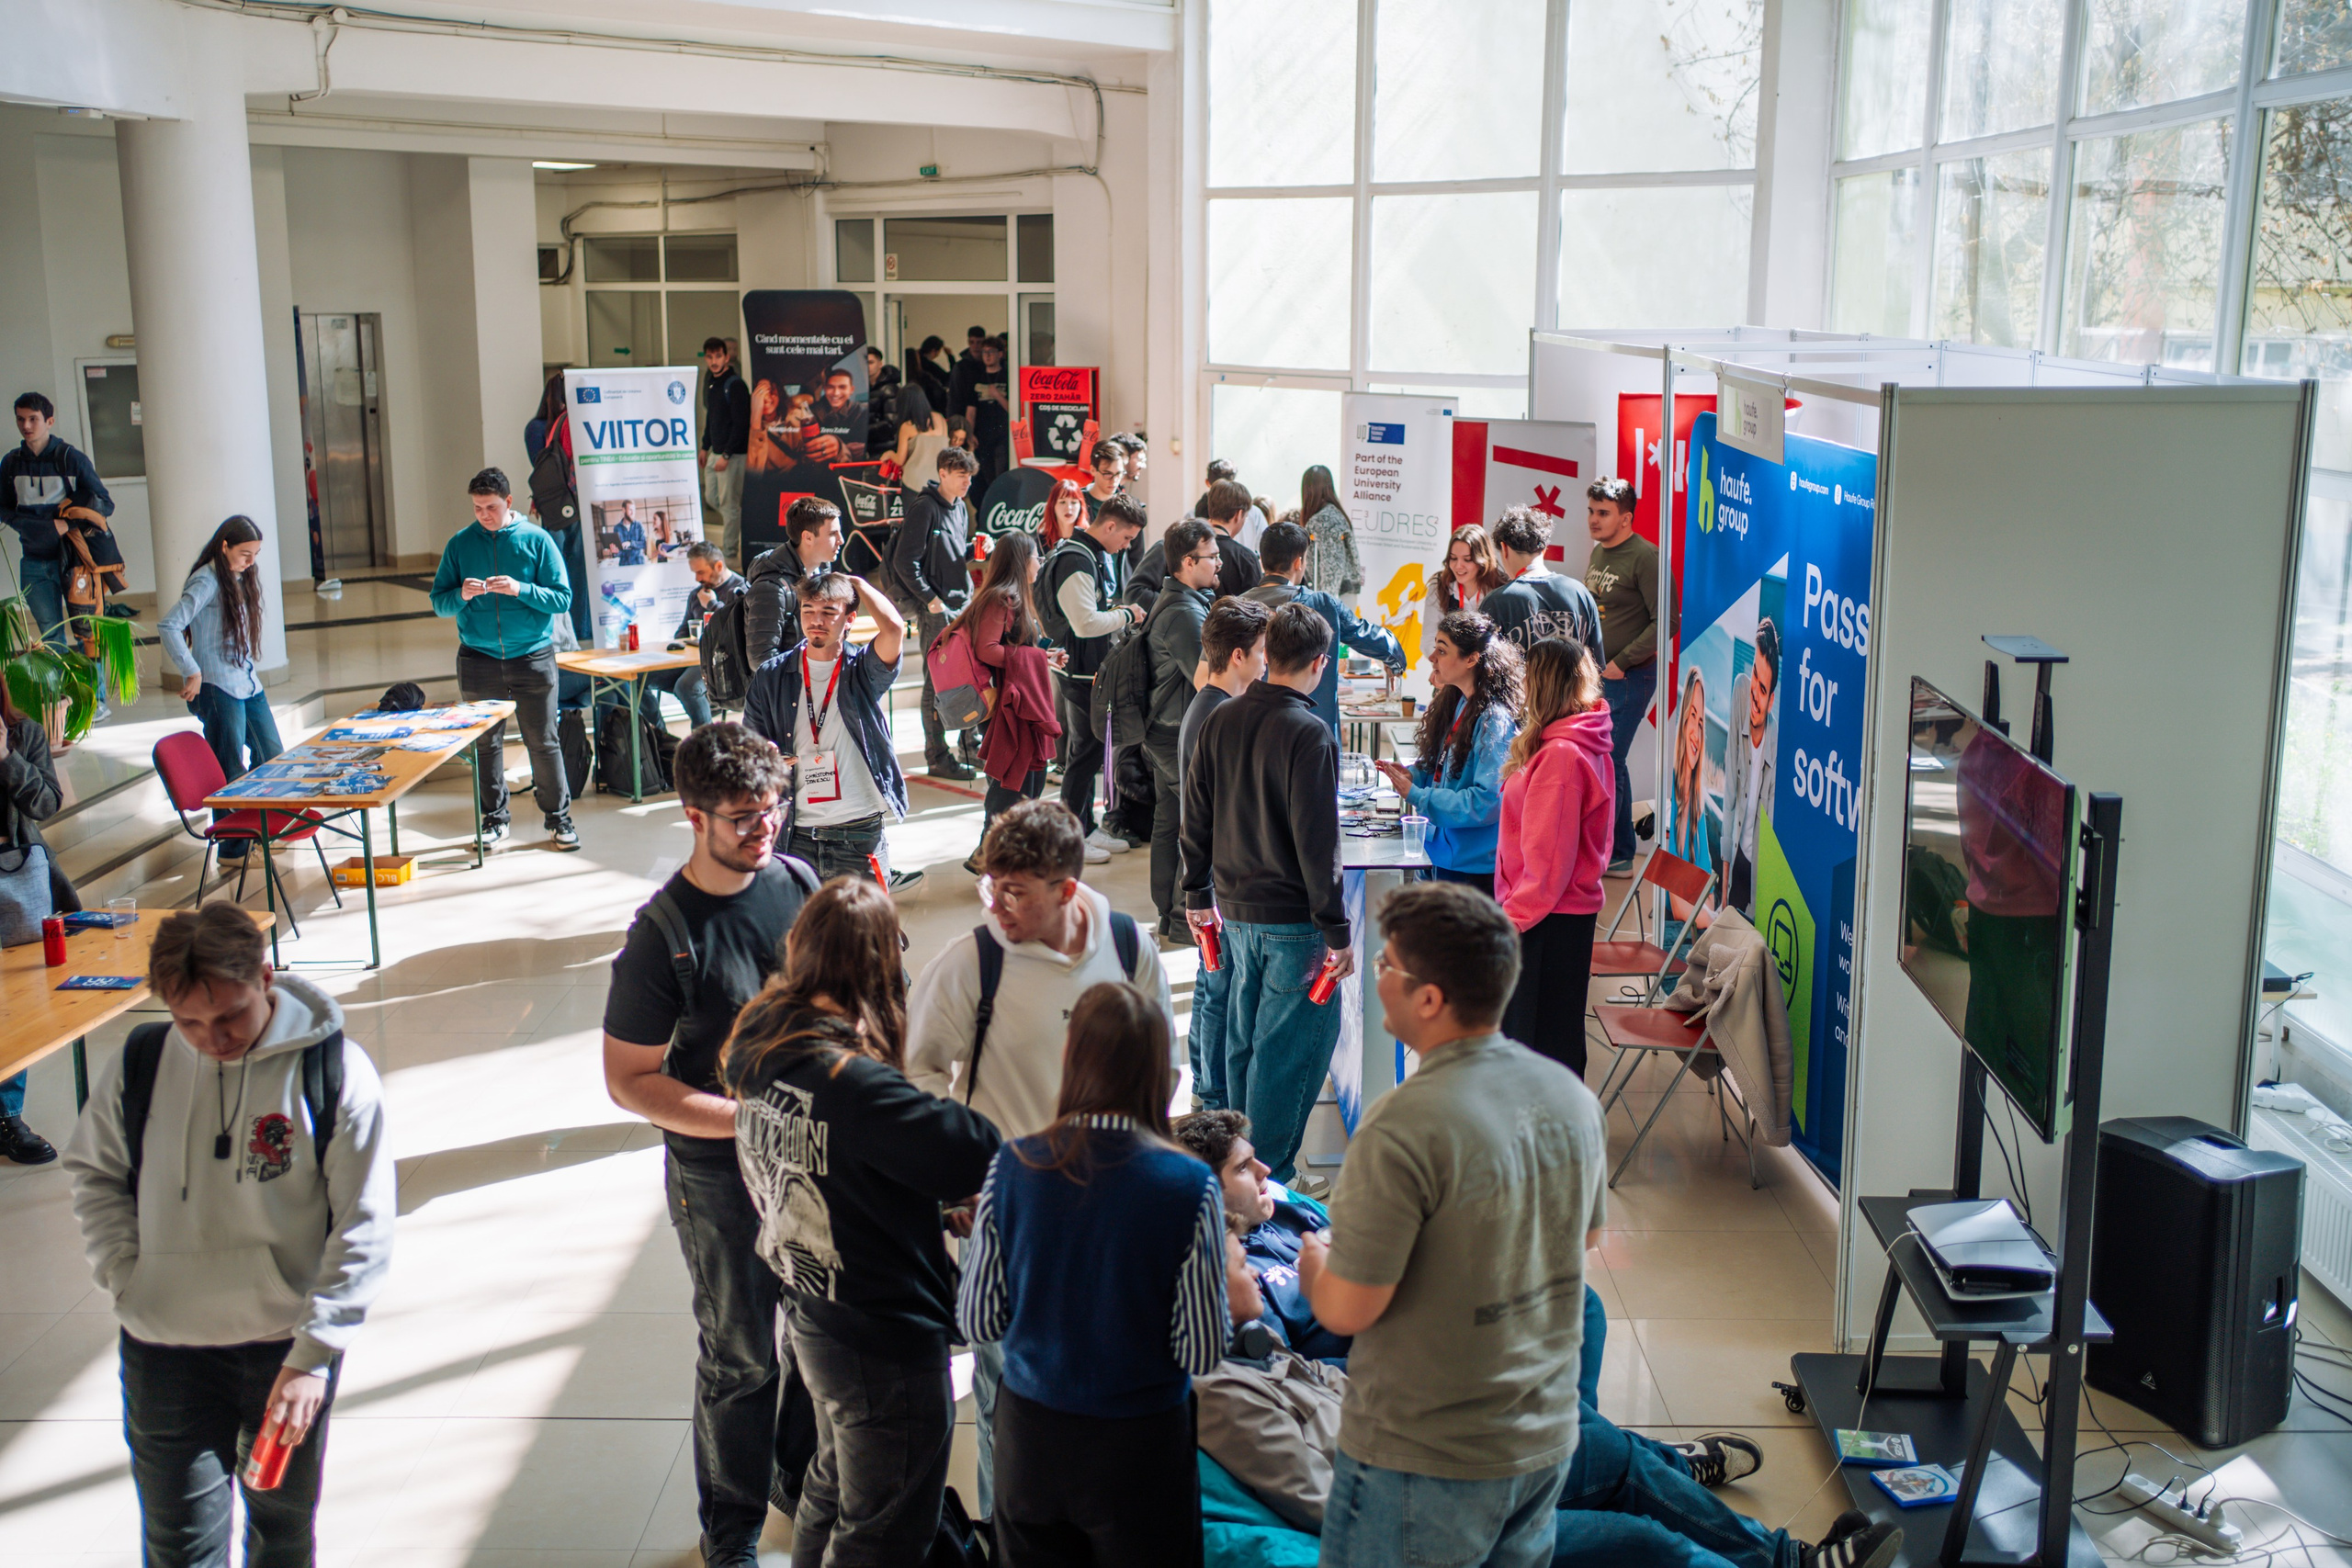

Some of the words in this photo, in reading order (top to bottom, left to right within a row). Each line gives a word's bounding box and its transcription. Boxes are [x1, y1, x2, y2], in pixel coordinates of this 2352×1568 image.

[755, 333, 778, 344] Când
[778, 334, 831, 344] momentele
[831, 336, 843, 344] cu
[844, 335, 854, 344] ei
[765, 345, 786, 355] sunt
[786, 345, 805, 355] cele
[806, 345, 824, 355] mai
[582, 418, 690, 449] VIITOR
[1743, 419, 1757, 440] group
[1355, 453, 1375, 463] Part
[1376, 454, 1386, 463] of
[1387, 455, 1403, 465] the
[1354, 466, 1399, 478] European
[1353, 478, 1402, 492] University
[1720, 467, 1752, 505] haufe.
[1352, 491, 1392, 502] Alliance
[1857, 494, 1870, 511] Group
[1718, 502, 1749, 541] group
[1803, 562, 1869, 657] Pass
[1799, 647, 1838, 728] for
[1840, 920, 1853, 946] We
